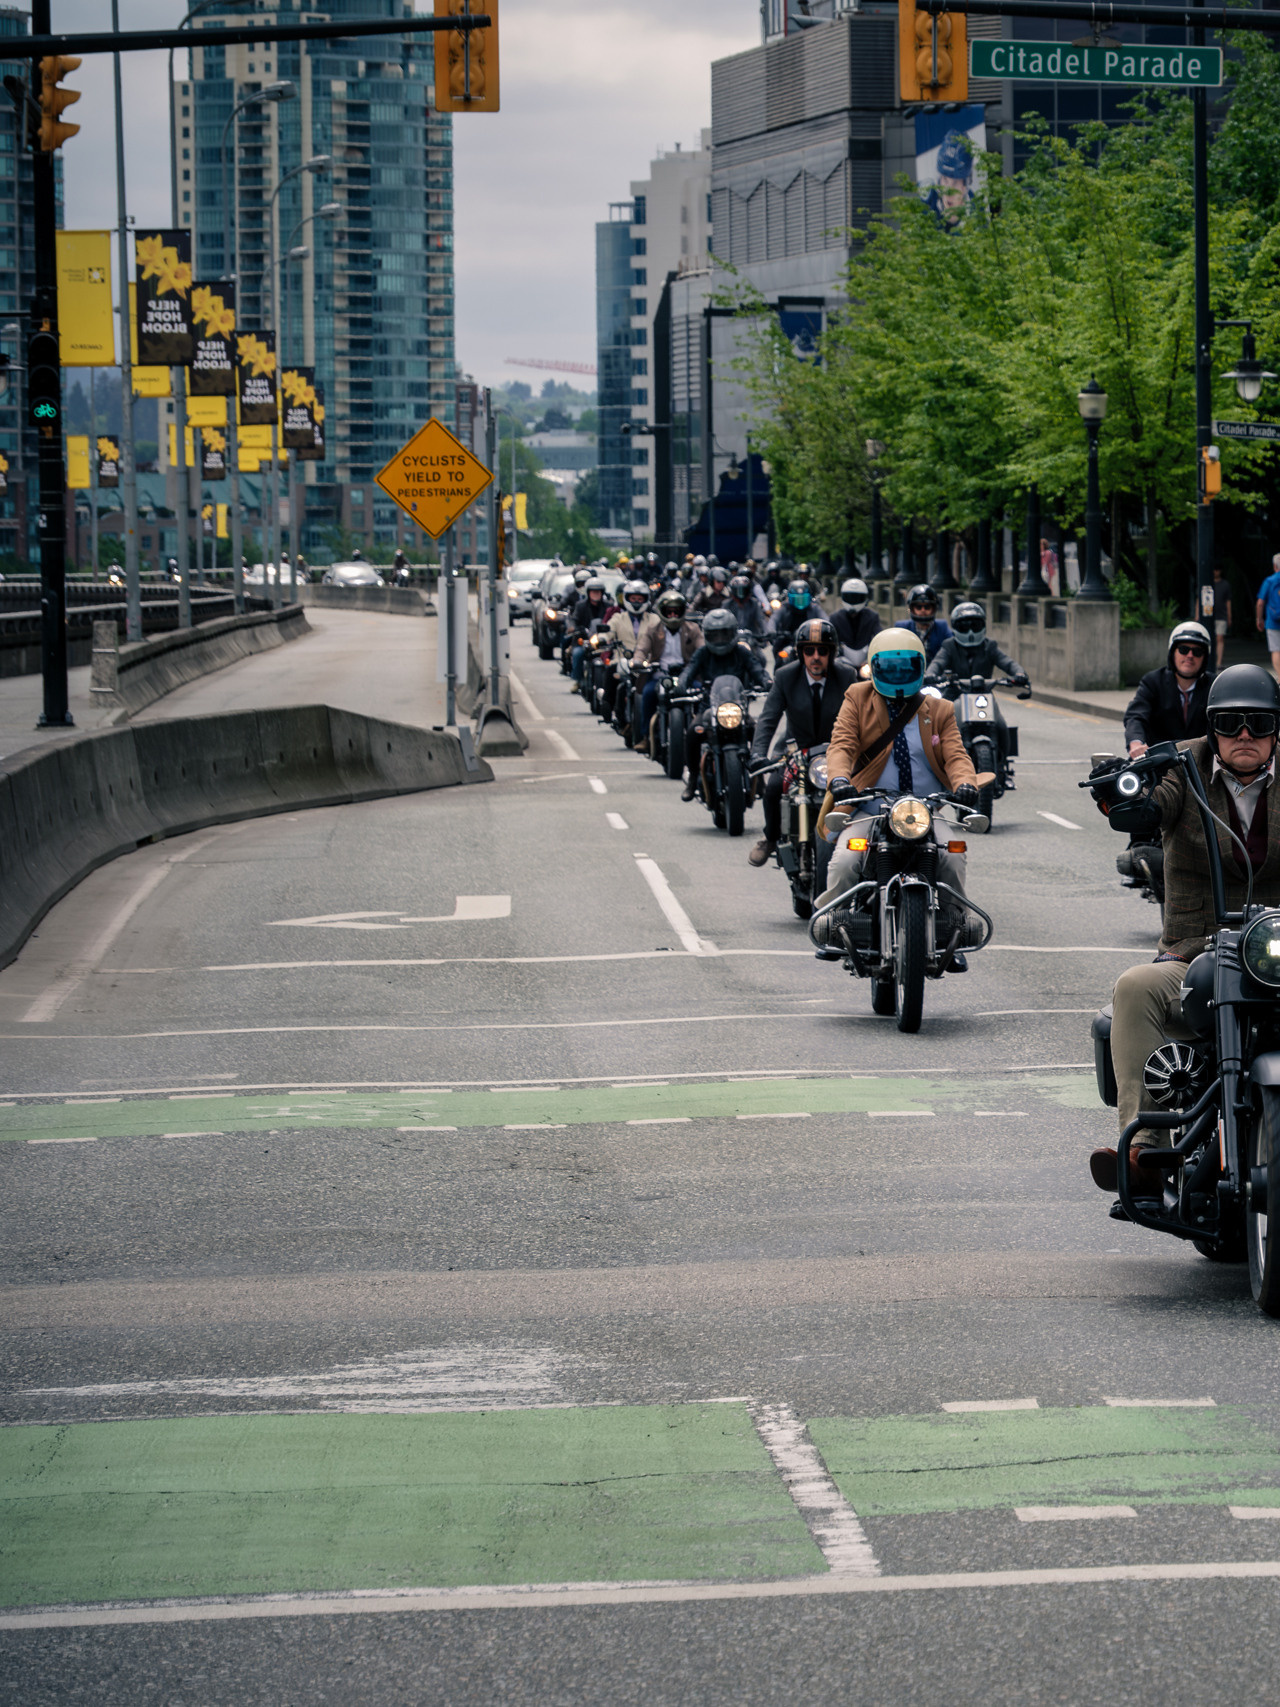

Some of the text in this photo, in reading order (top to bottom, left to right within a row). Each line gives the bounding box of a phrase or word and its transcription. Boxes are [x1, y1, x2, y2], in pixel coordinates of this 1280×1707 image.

[991, 46, 1201, 79] Citadel Parade
[1219, 423, 1247, 435] Citadel
[1248, 426, 1277, 437] Parade
[402, 455, 466, 467] CYCLISTS
[404, 471, 465, 483] YIELD TO
[397, 487, 471, 497] PEDESTRIANS
